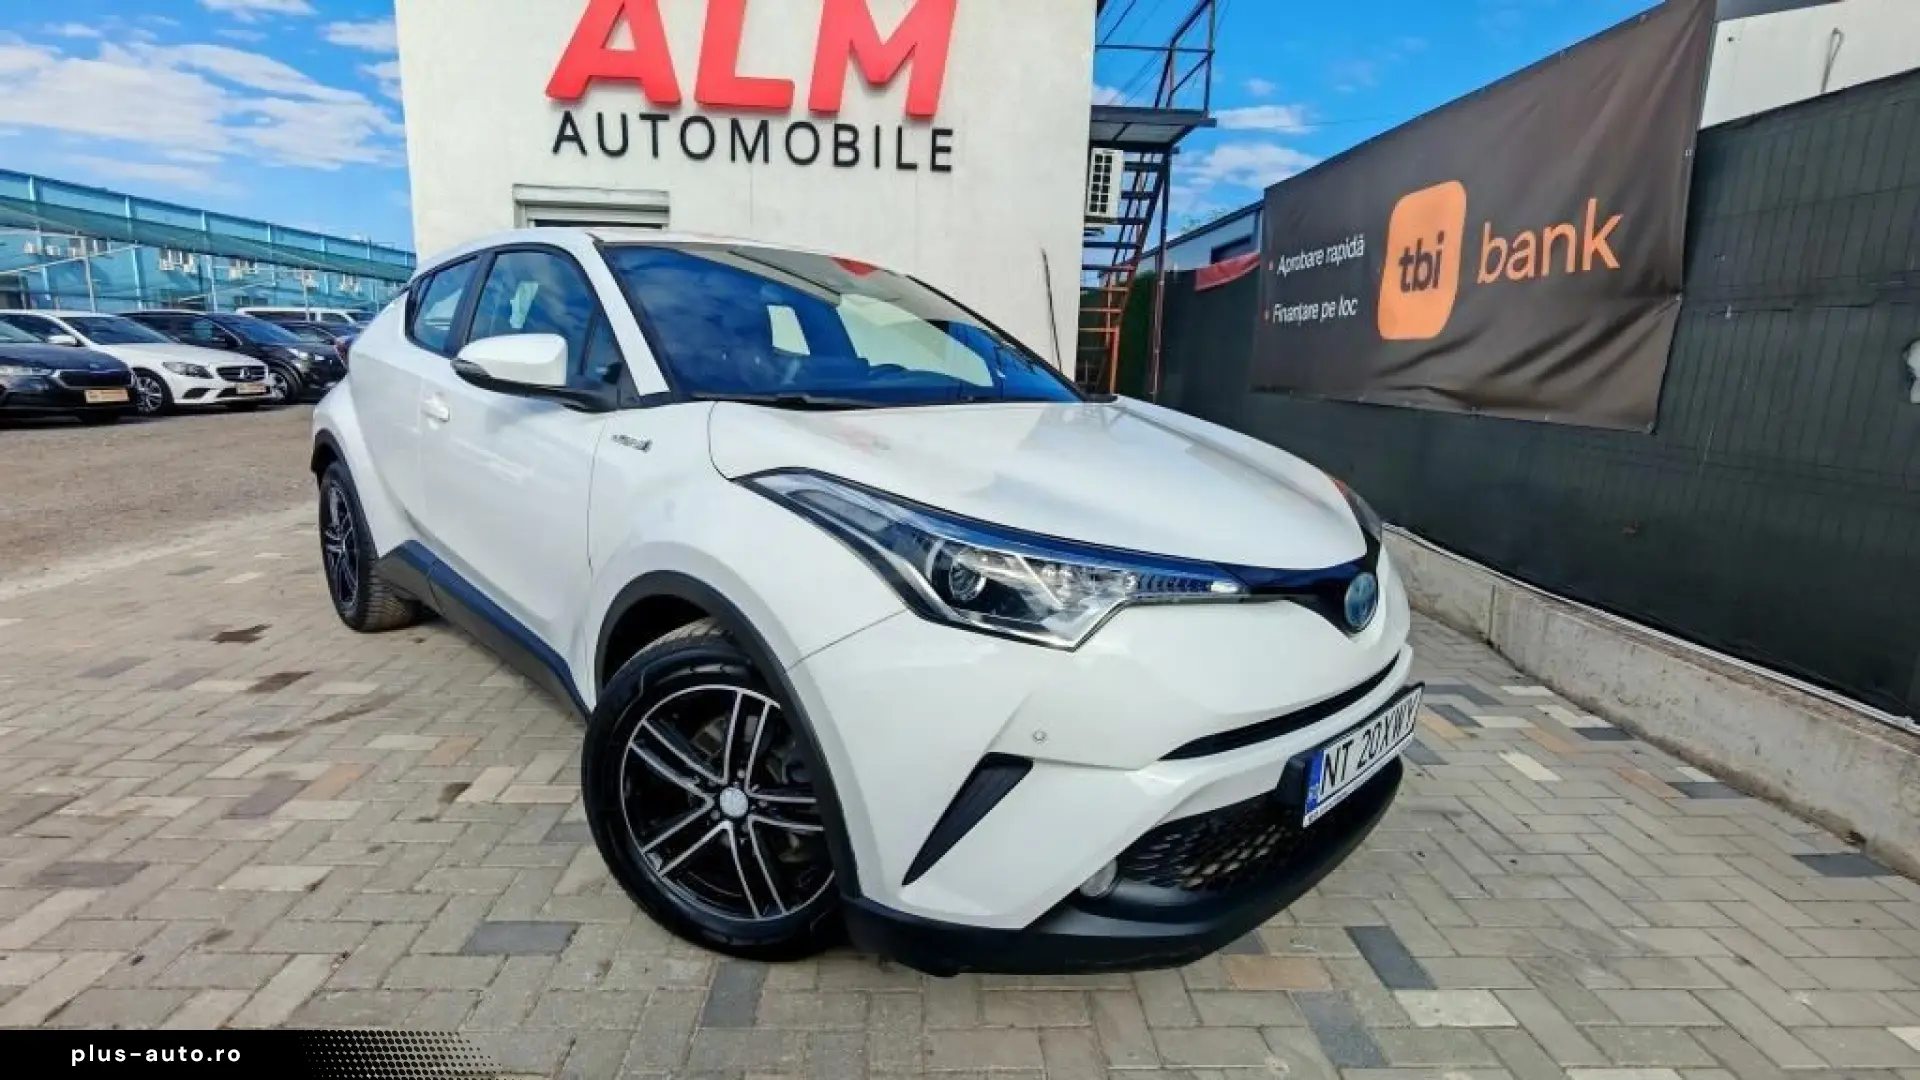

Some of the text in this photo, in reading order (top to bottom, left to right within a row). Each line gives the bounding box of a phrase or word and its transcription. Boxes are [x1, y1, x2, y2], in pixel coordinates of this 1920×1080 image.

[545, 0, 957, 121] ALM
[552, 110, 954, 172] AUTOMOBILE
[1276, 249, 1324, 278] Aprobare
[1398, 197, 1624, 293] tbi bank
[1320, 301, 1336, 323] pe
[1339, 294, 1358, 316] loc
[1320, 740, 1355, 796] NT
